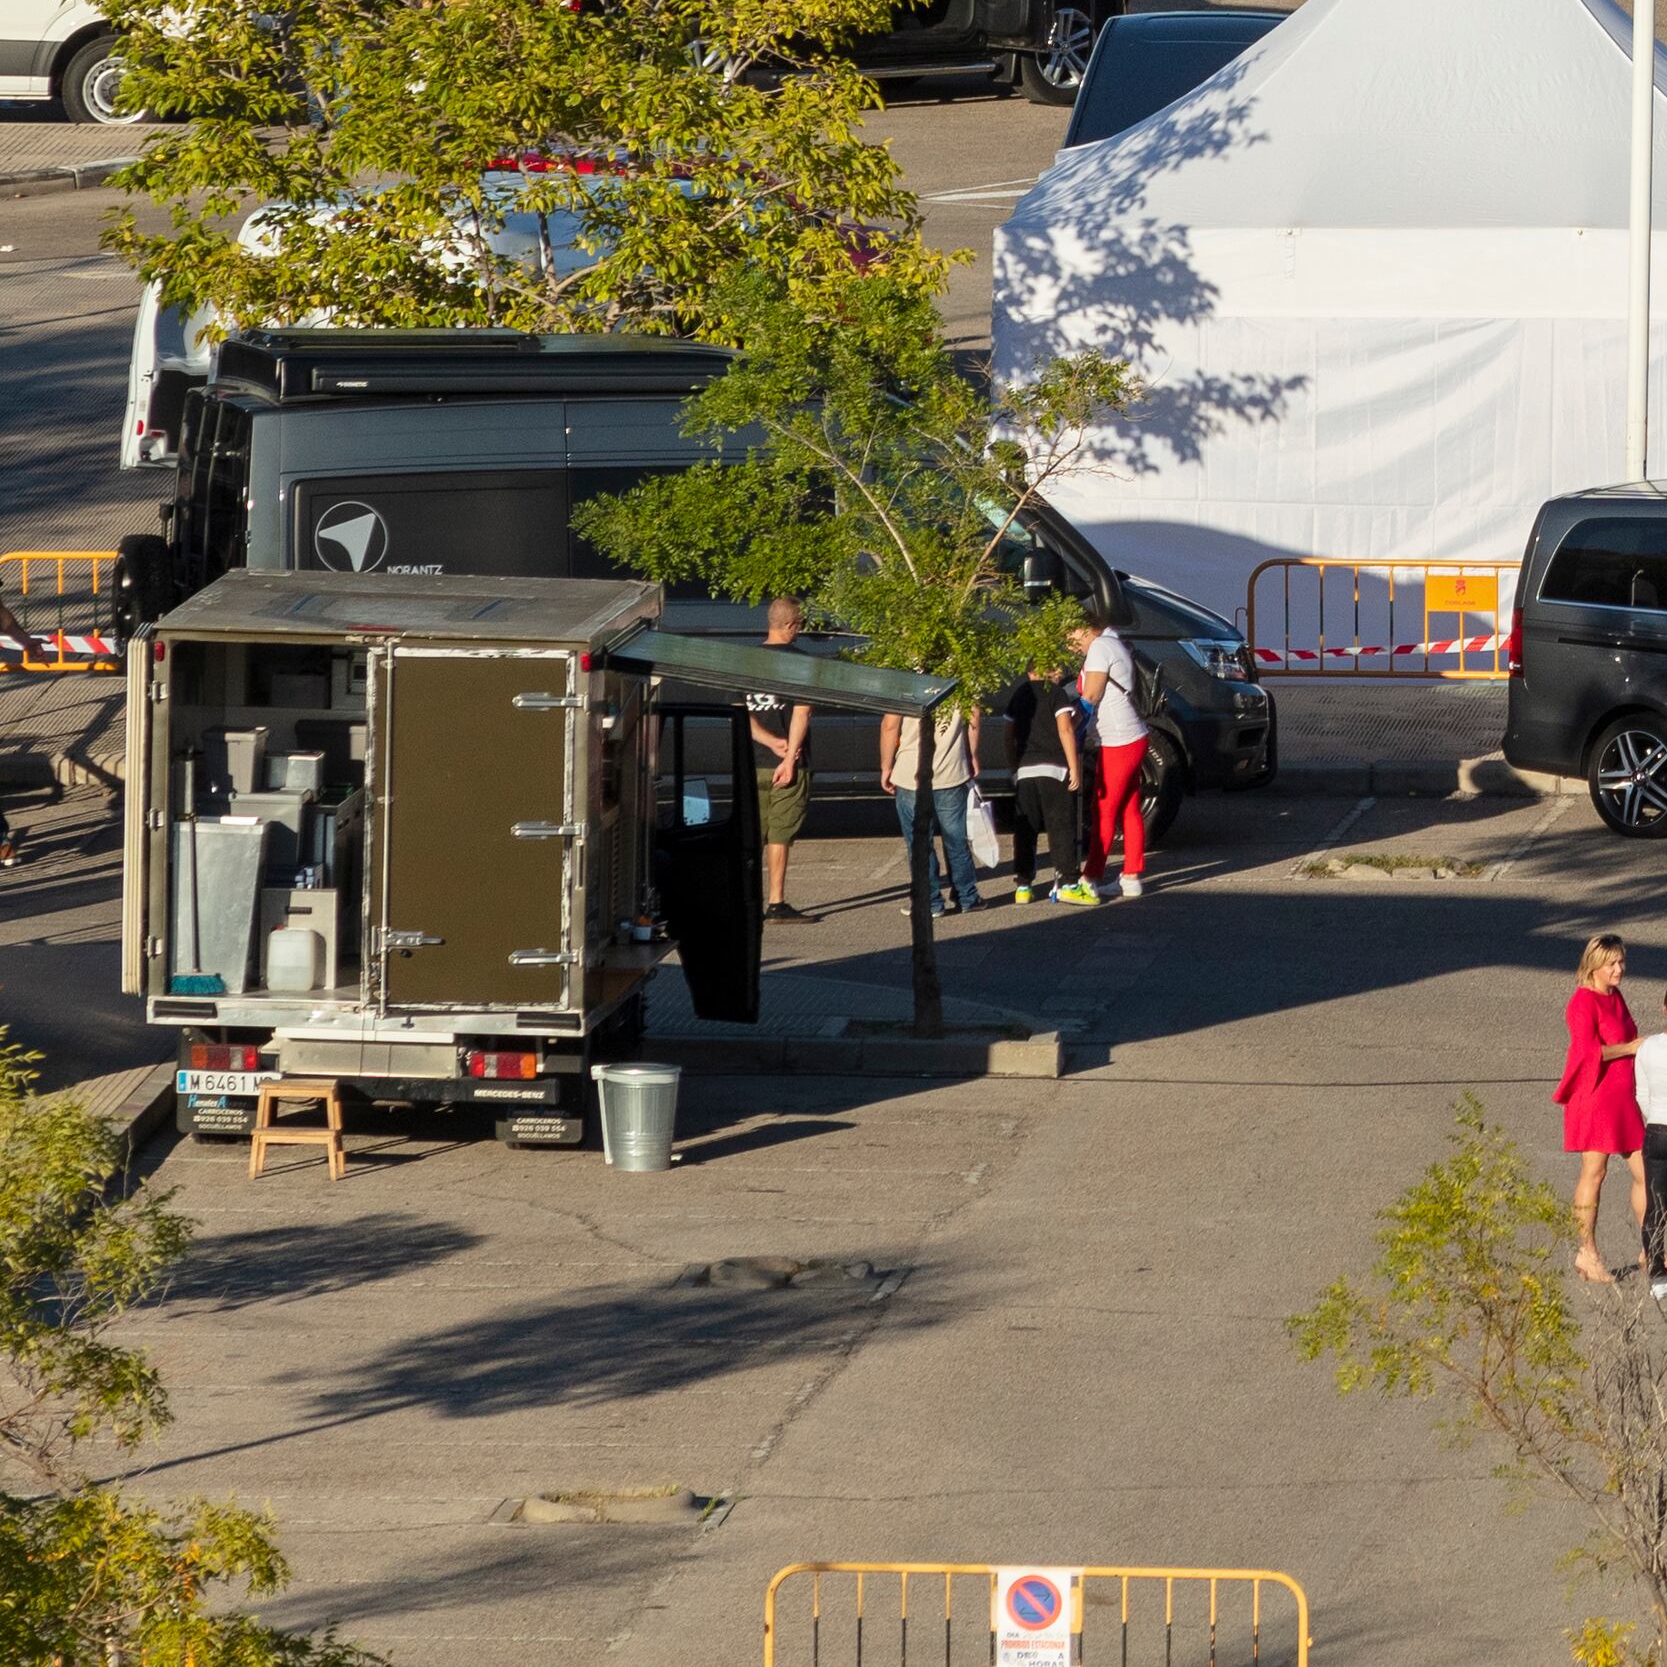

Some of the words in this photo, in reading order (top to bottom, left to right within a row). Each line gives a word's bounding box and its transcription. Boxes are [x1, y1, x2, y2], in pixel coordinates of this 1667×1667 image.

[386, 564, 443, 575] NORANTZ
[190, 1075, 200, 1090] M
[205, 1074, 246, 1091] 6461
[473, 1089, 546, 1099] MERCEDES-BENZ
[197, 1108, 244, 1116] CARROCEROS
